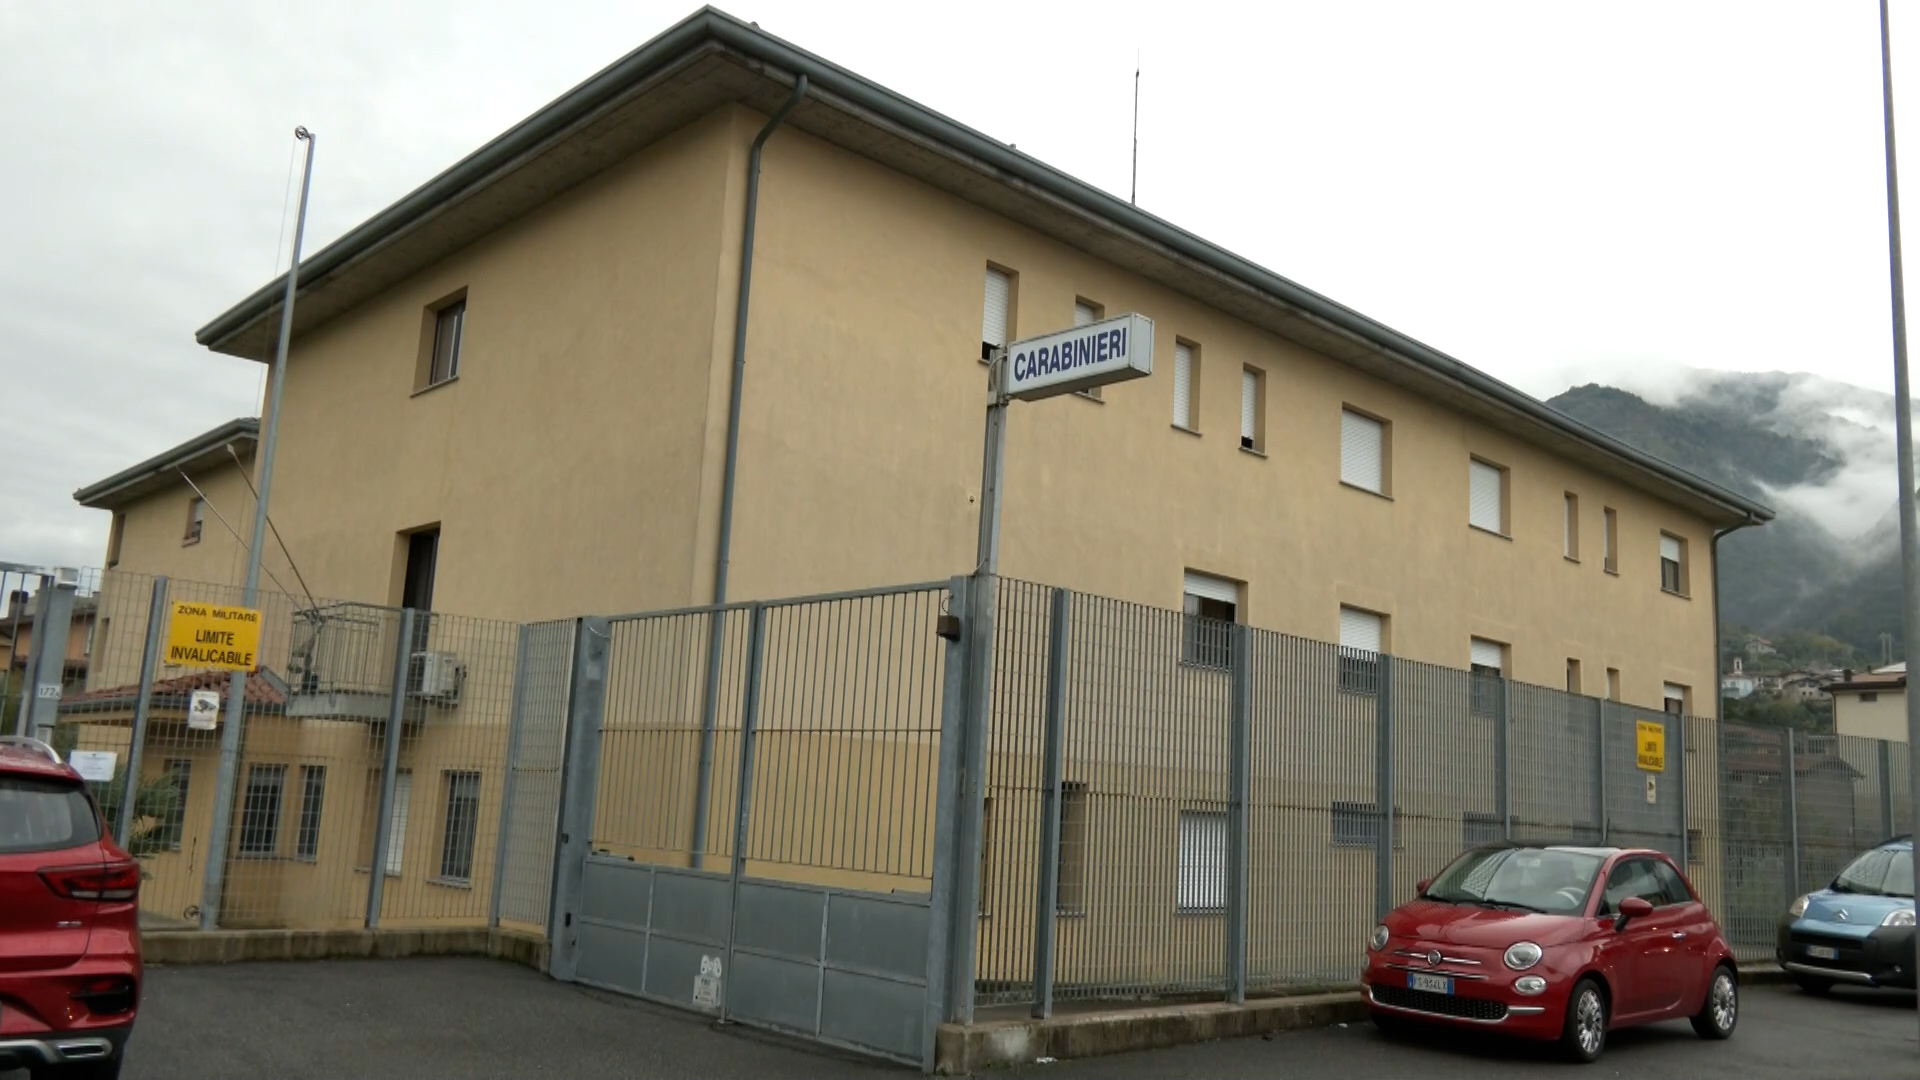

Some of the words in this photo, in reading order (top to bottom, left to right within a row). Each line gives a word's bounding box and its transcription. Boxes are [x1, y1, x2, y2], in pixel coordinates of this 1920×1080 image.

[1014, 327, 1127, 381] CARABINIERI
[178, 605, 207, 616] ZONA
[212, 609, 258, 622] MILITARE
[195, 629, 235, 646] LIMITE
[170, 645, 253, 666] INVALICABILE
